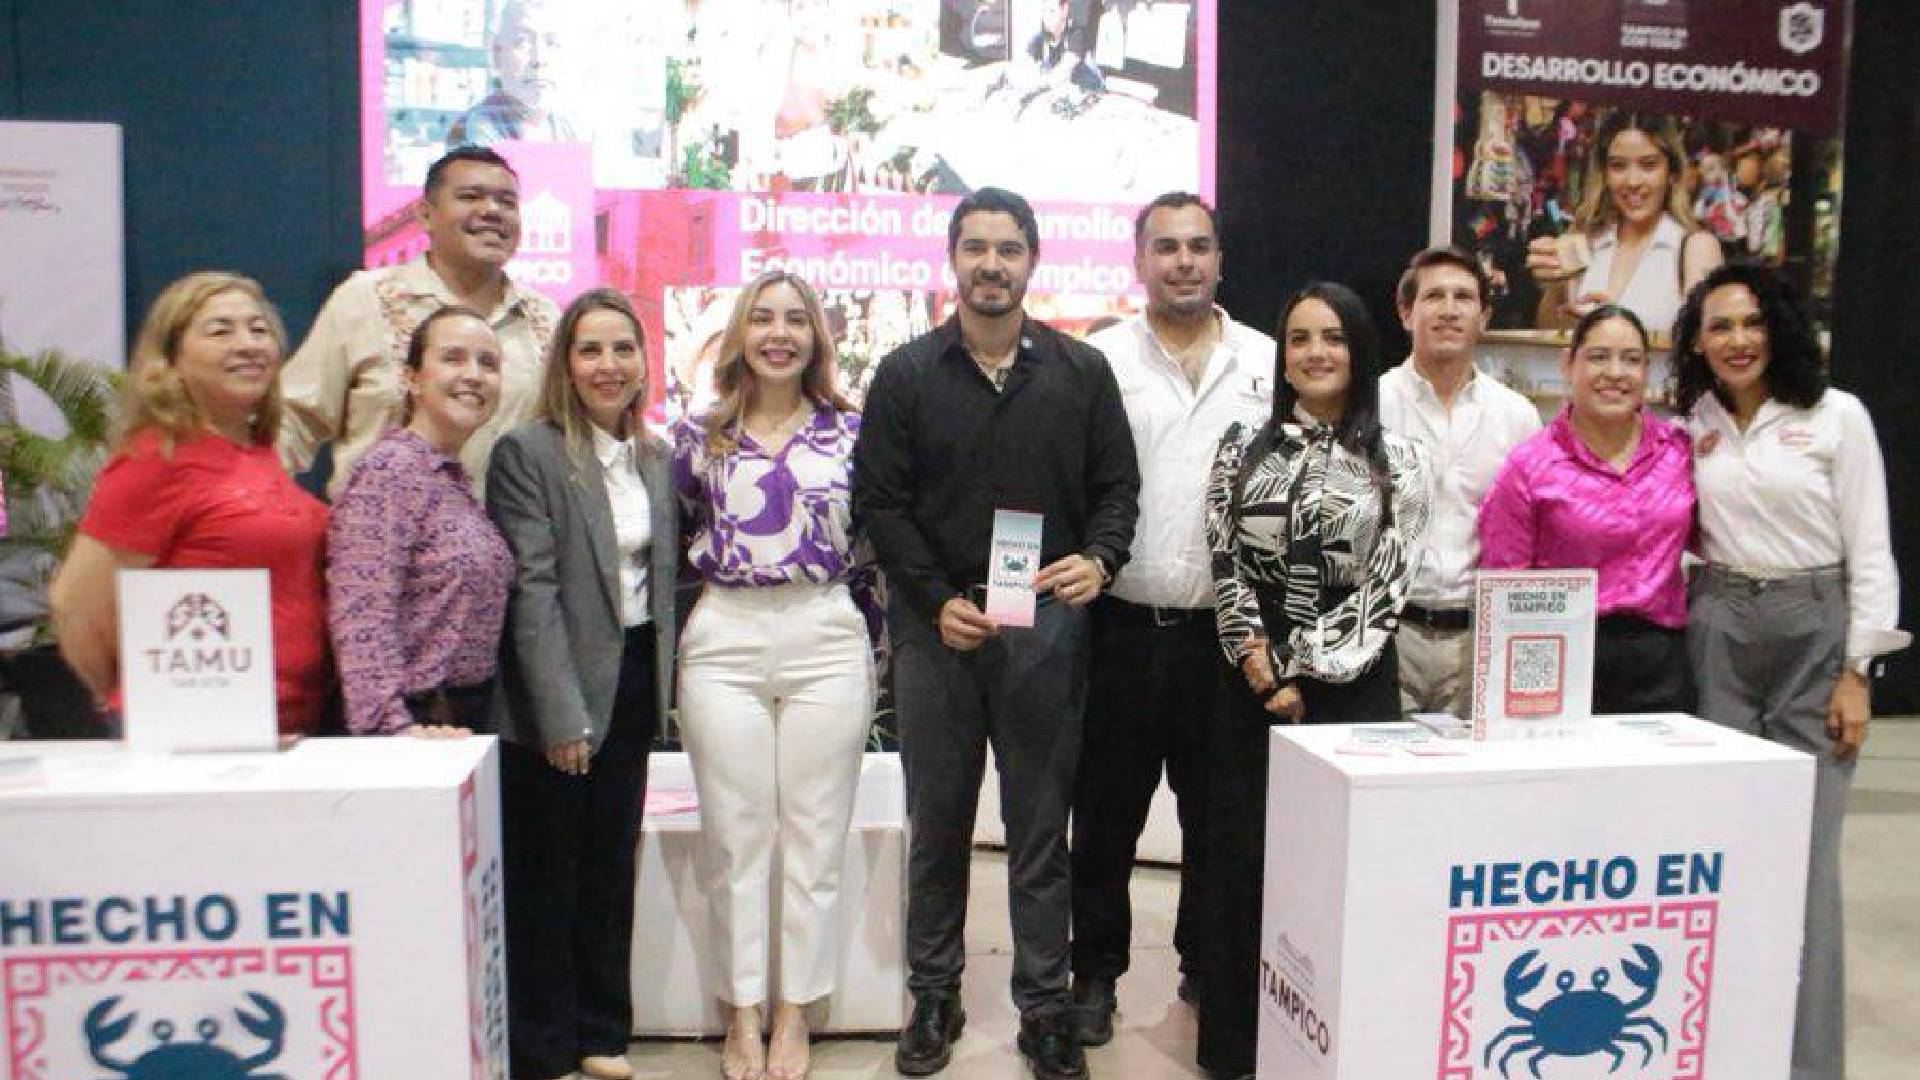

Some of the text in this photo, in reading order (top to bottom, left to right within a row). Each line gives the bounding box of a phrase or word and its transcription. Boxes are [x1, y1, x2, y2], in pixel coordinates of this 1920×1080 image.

[1482, 51, 1820, 97] DESARROLLO ECONÓMICO
[741, 196, 901, 235] Dirección
[1036, 206, 1132, 241] rrollo
[1032, 256, 1132, 297] mpico
[1507, 591, 1567, 601] HECHO EN
[1508, 601, 1566, 614] TAMPICO
[143, 647, 253, 674] TAMU
[1449, 851, 1723, 908] HECHO EN
[0, 891, 351, 946] HECHO EN
[1260, 958, 1330, 1056] TAMPICO
